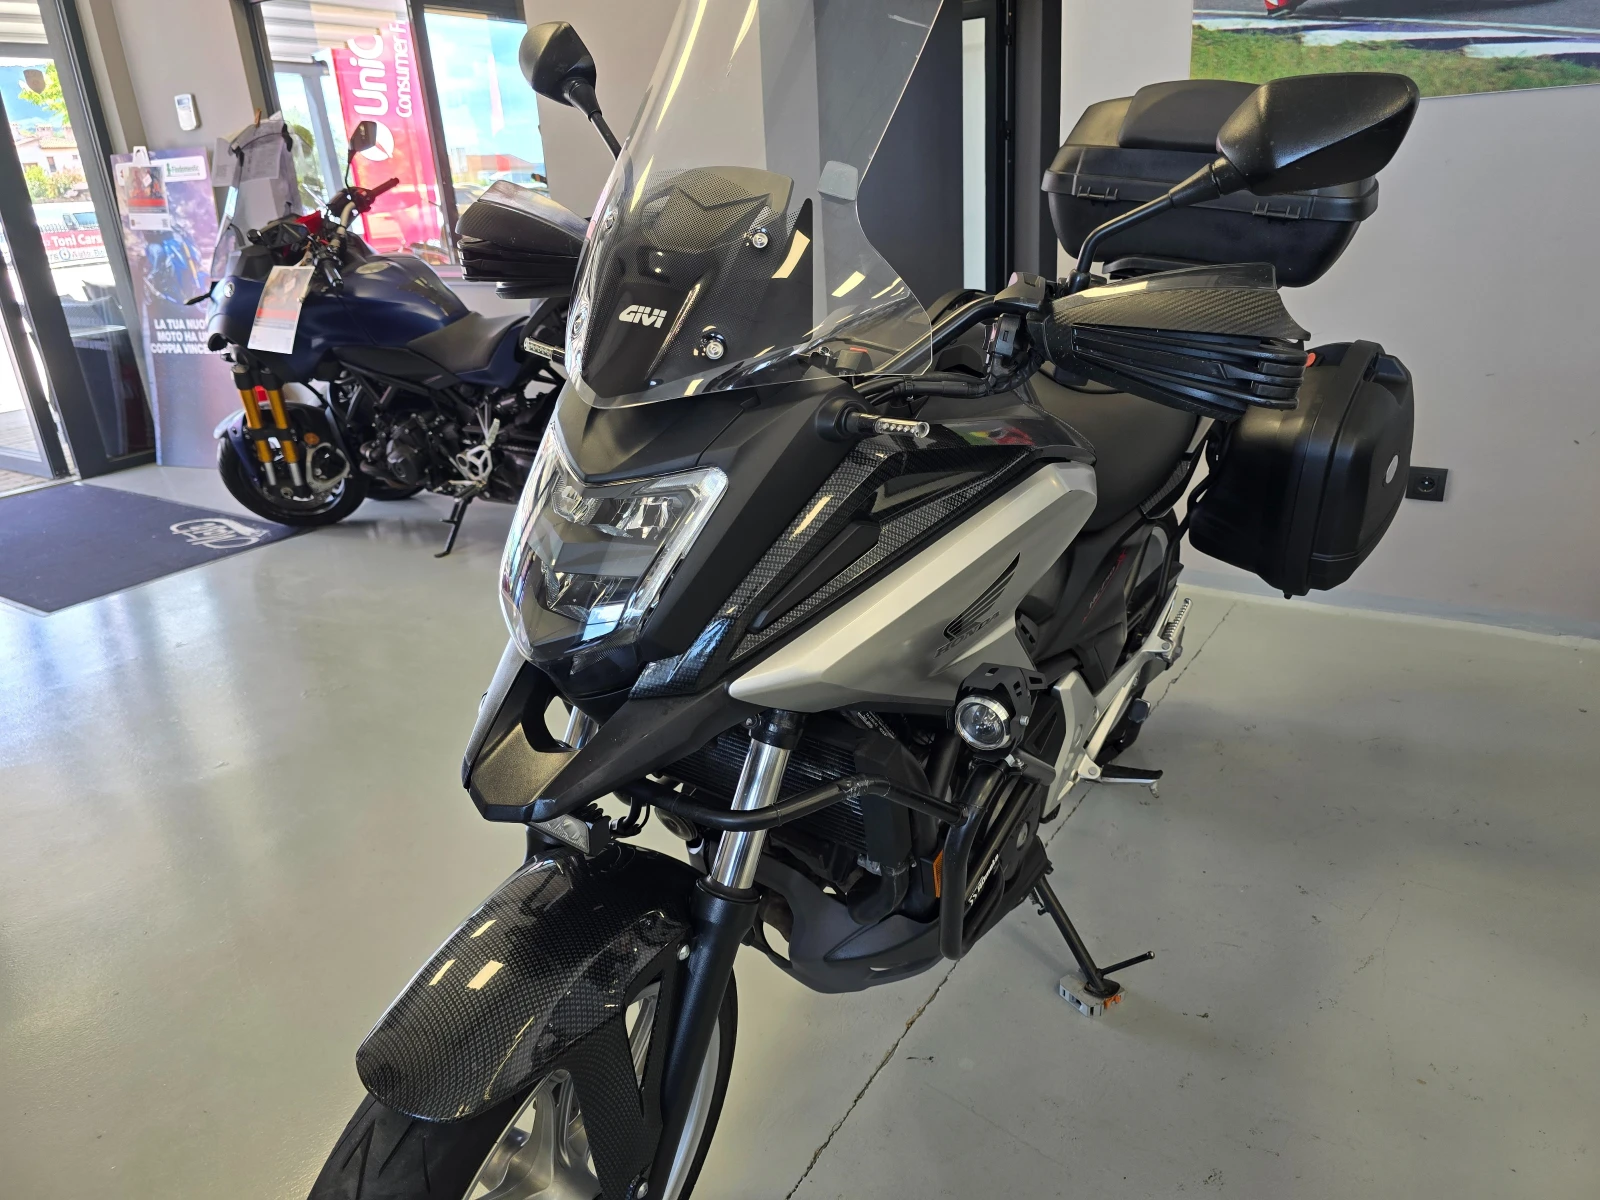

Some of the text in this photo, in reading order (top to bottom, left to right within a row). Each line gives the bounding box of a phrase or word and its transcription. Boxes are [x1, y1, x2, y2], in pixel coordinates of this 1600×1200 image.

[392, 35, 413, 118] Consumer
[50, 233, 102, 247] Toni Cars
[618, 304, 668, 329] GIVI
[153, 318, 167, 330] LA
[167, 318, 186, 330] TUA
[156, 331, 184, 342] MOTO
[184, 331, 199, 342] HA
[150, 342, 183, 354] COPPIA
[932, 610, 1000, 660] HONDA
